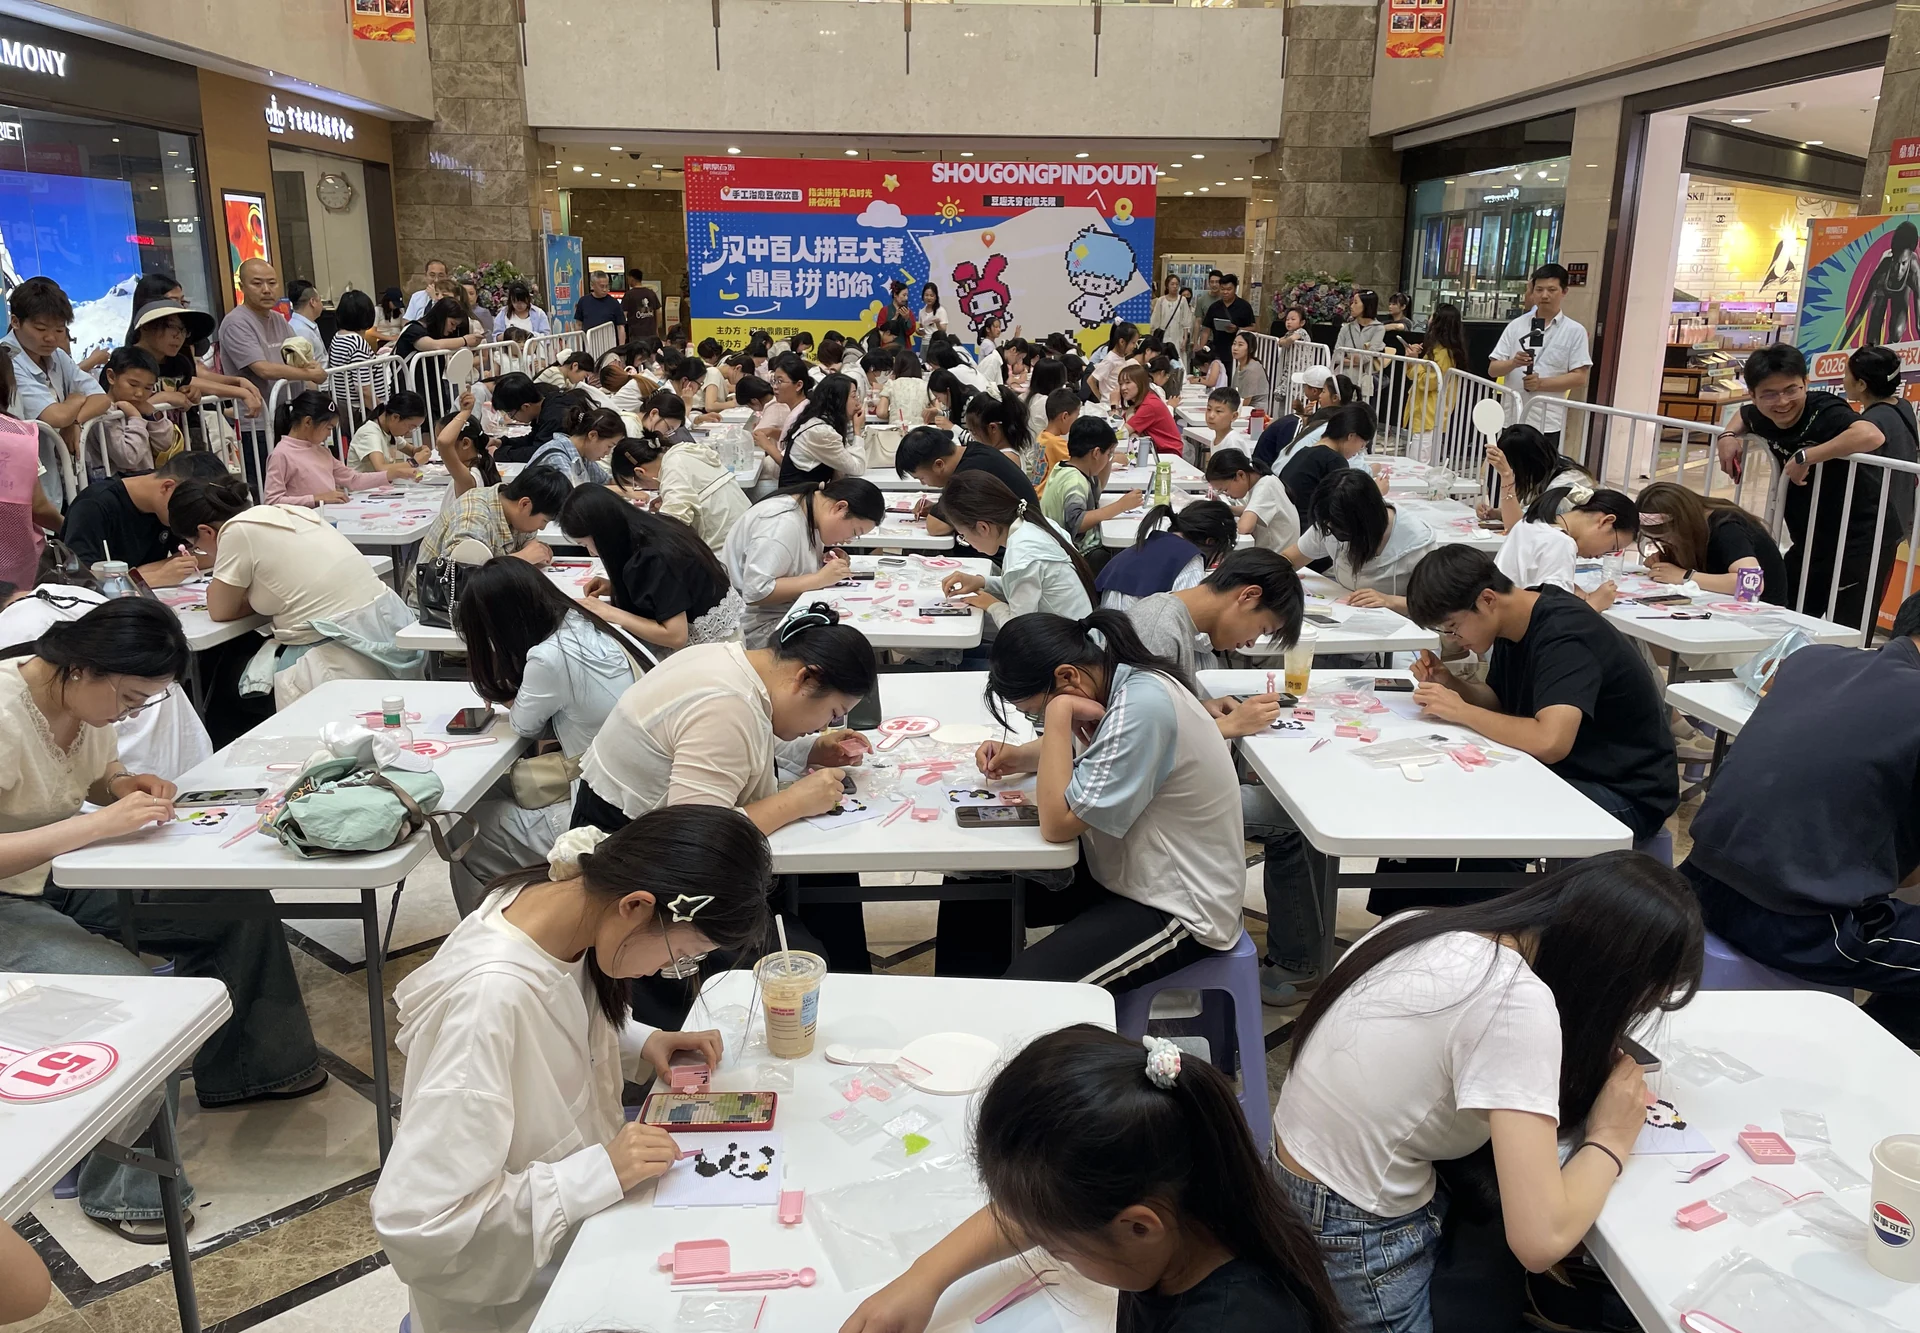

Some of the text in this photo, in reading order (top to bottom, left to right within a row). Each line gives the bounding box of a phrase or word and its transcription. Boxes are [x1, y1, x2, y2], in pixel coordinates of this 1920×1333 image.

[0, 38, 66, 76] MONY
[931, 163, 1158, 186] SHOUGONGPINDOUDIY
[732, 190, 799, 201] 手工治愈豆你欢喜
[808, 198, 841, 207] 拼你所爱
[702, 235, 904, 275] 汉中百人拼豆大赛
[746, 267, 874, 310] 鼎最拼的你
[1818, 357, 1846, 375] 2026
[886, 720, 929, 732] 35
[11, 1051, 97, 1087] 51
[1873, 1210, 1911, 1237] 百事可乐
